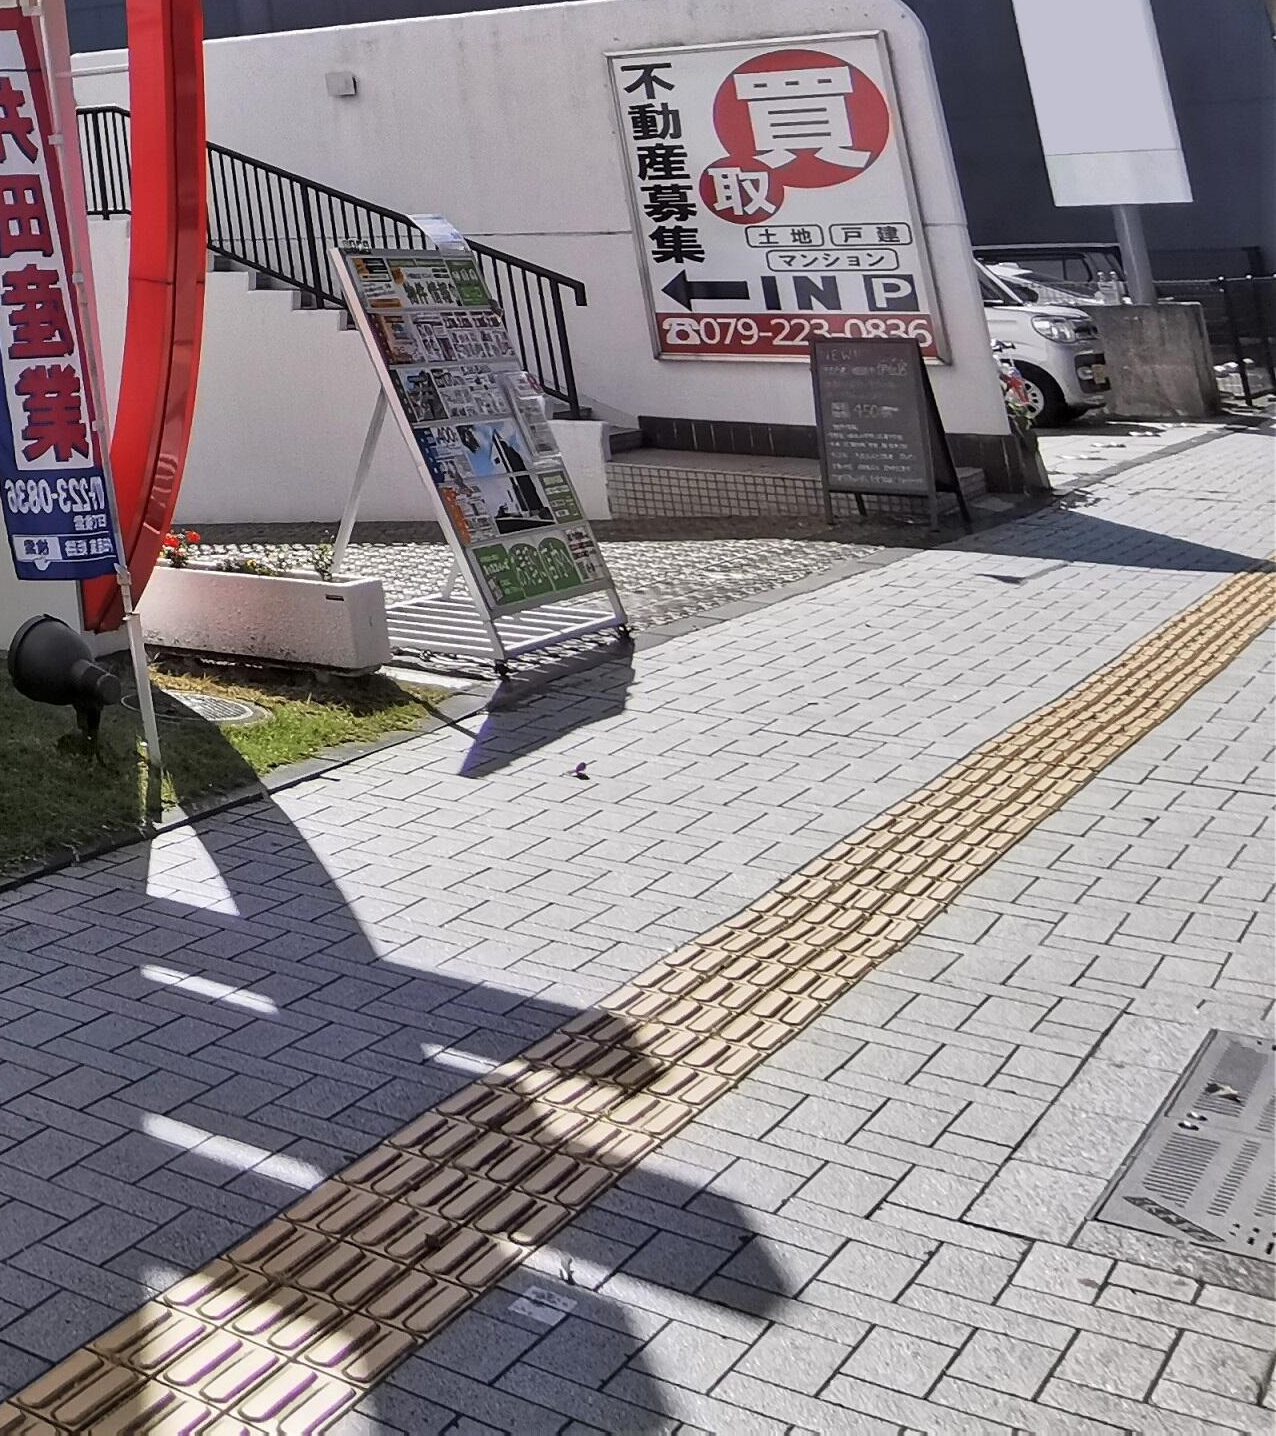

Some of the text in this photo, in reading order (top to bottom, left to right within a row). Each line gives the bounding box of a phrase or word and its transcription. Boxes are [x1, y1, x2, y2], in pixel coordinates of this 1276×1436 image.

[620, 62, 705, 264] 不動産募集
[758, 226, 900, 245] 土地 戸建
[778, 253, 886, 268] マンション
[760, 275, 842, 311] IN
